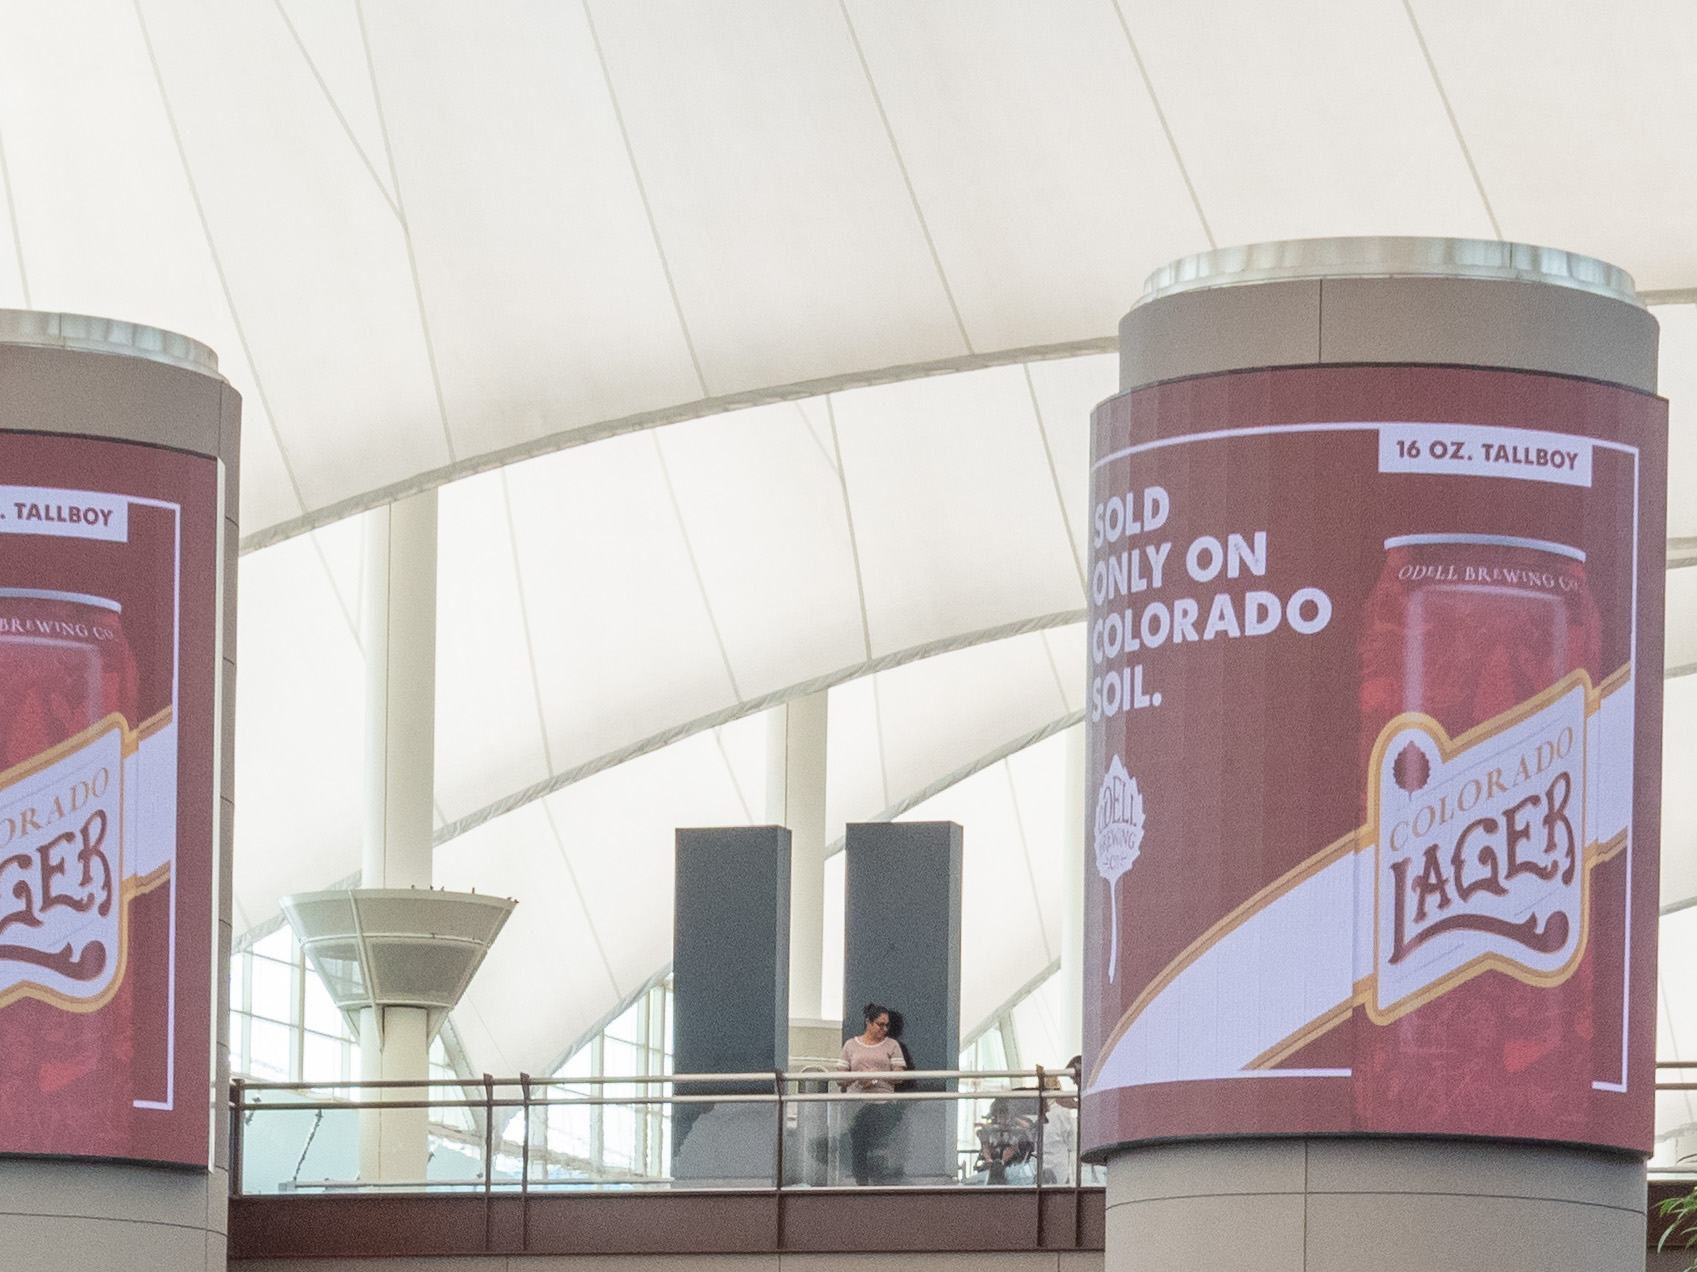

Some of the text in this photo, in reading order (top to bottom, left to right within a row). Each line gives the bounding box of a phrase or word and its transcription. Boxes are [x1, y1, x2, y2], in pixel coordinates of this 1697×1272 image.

[1396, 440, 1579, 471] 16 OZ. TALLBOY
[13, 502, 114, 527] TALLBOY
[1093, 486, 1170, 549] SOLD
[1092, 531, 1267, 606] ONLY ON
[1398, 564, 1458, 581] ODELL
[1464, 565, 1555, 588] BREWING
[1092, 587, 1333, 664] COLORADO
[1091, 663, 1163, 722] SOIL.
[1389, 726, 1574, 852] COLORADO
[1387, 771, 1575, 965] LAGER
